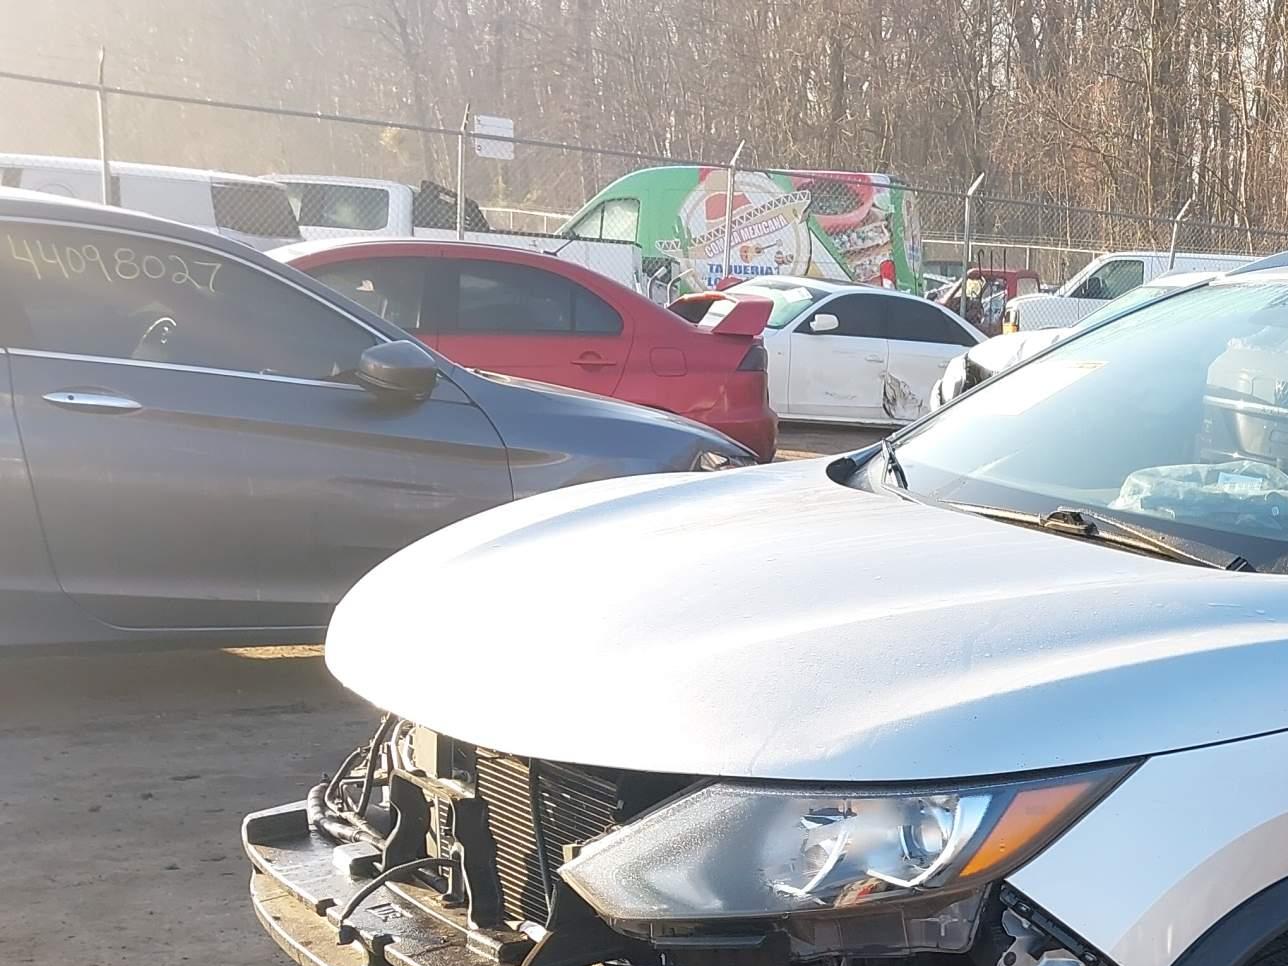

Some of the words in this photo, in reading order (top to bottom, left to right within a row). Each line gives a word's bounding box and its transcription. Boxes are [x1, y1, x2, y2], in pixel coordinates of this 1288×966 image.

[740, 214, 788, 240] MEXICANA
[7, 234, 222, 292] 44098027
[707, 263, 775, 275] TAUERIA
